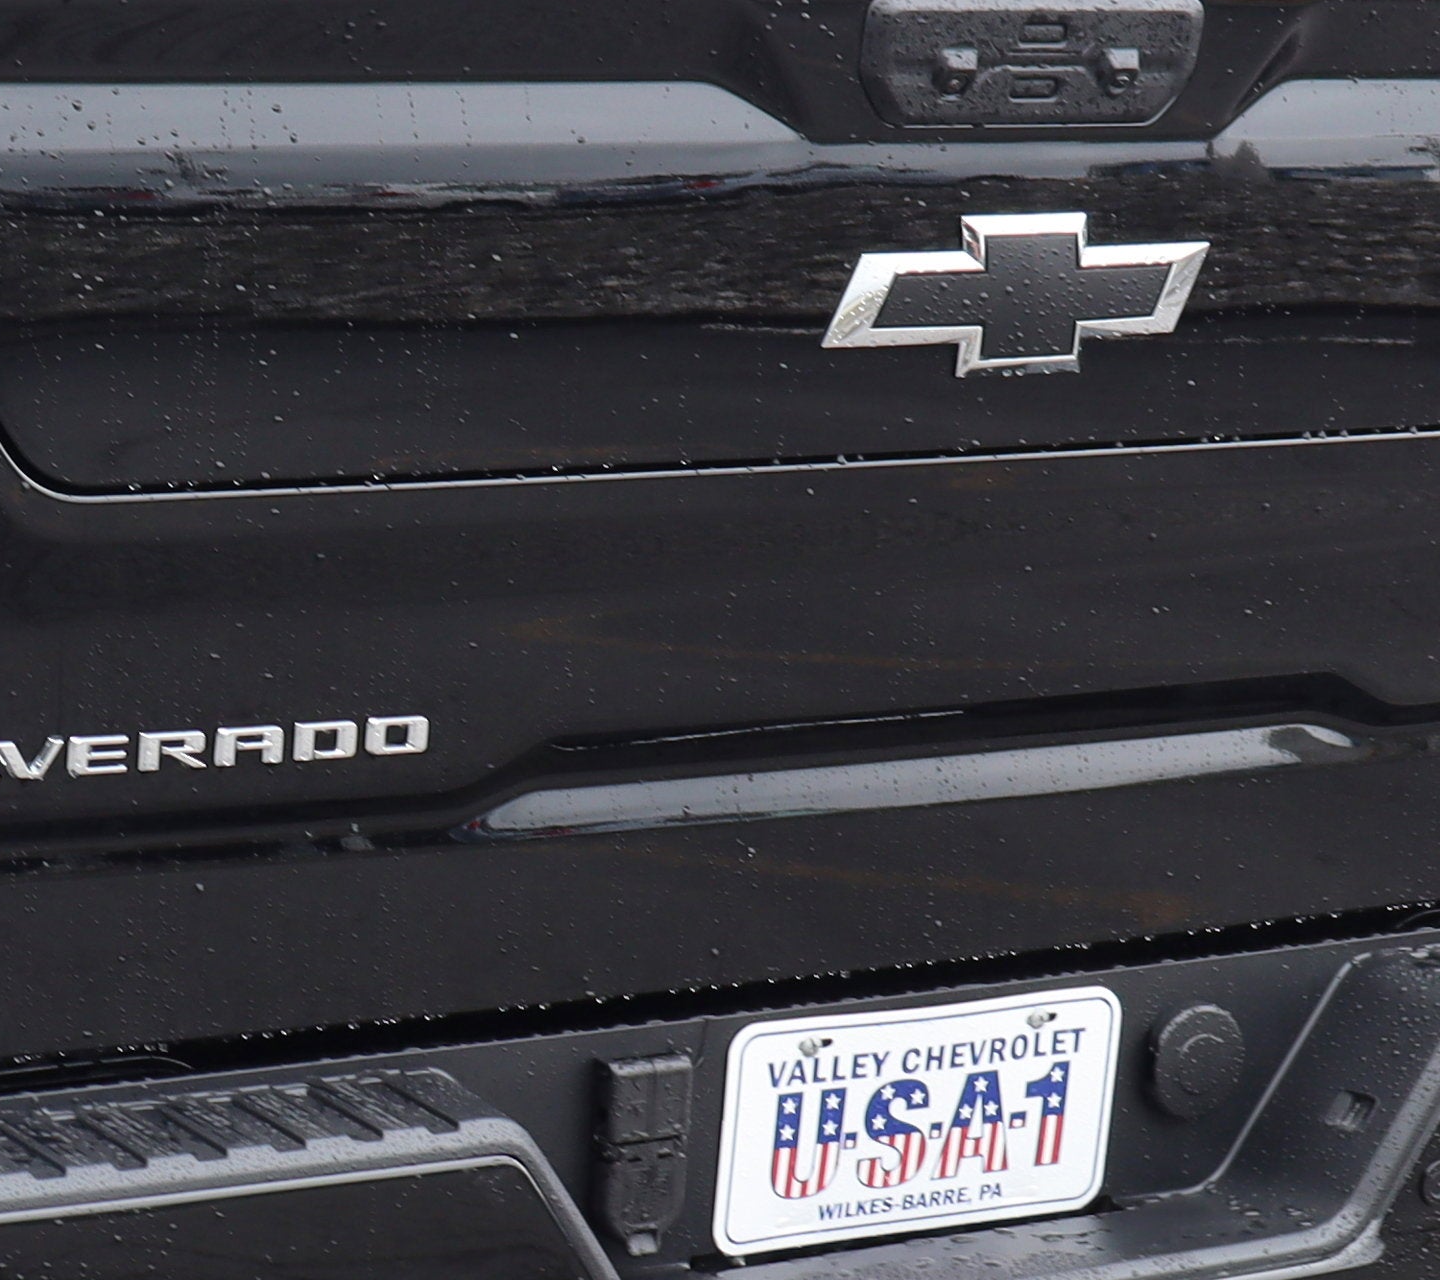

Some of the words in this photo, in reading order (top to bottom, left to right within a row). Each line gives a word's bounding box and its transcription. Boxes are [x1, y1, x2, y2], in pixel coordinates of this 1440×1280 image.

[768, 1051, 889, 1088] VALLEY
[902, 1028, 1087, 1075] CHEVROLET
[817, 1190, 972, 1221] WILKES-BARRE,
[979, 1182, 1003, 1201] PA
